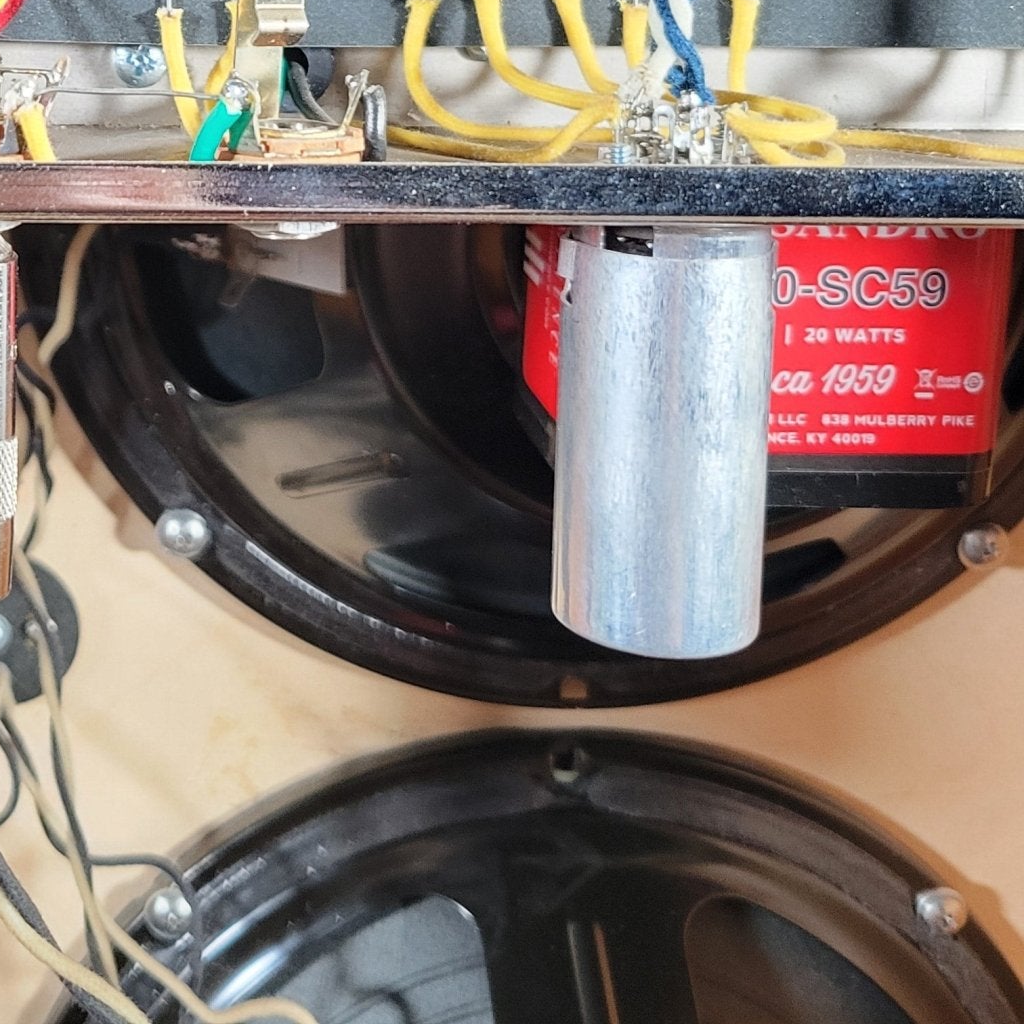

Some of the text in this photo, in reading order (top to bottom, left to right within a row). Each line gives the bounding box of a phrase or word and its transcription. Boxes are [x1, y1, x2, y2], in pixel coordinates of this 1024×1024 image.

[804, 328, 907, 344] 20 WATTS
[821, 364, 897, 395] 1959
[778, 414, 807, 426] LLC
[854, 415, 937, 427] MULBERRY
[942, 415, 975, 427] PIKE
[806, 432, 830, 444] KY
[832, 433, 876, 445] 40019
